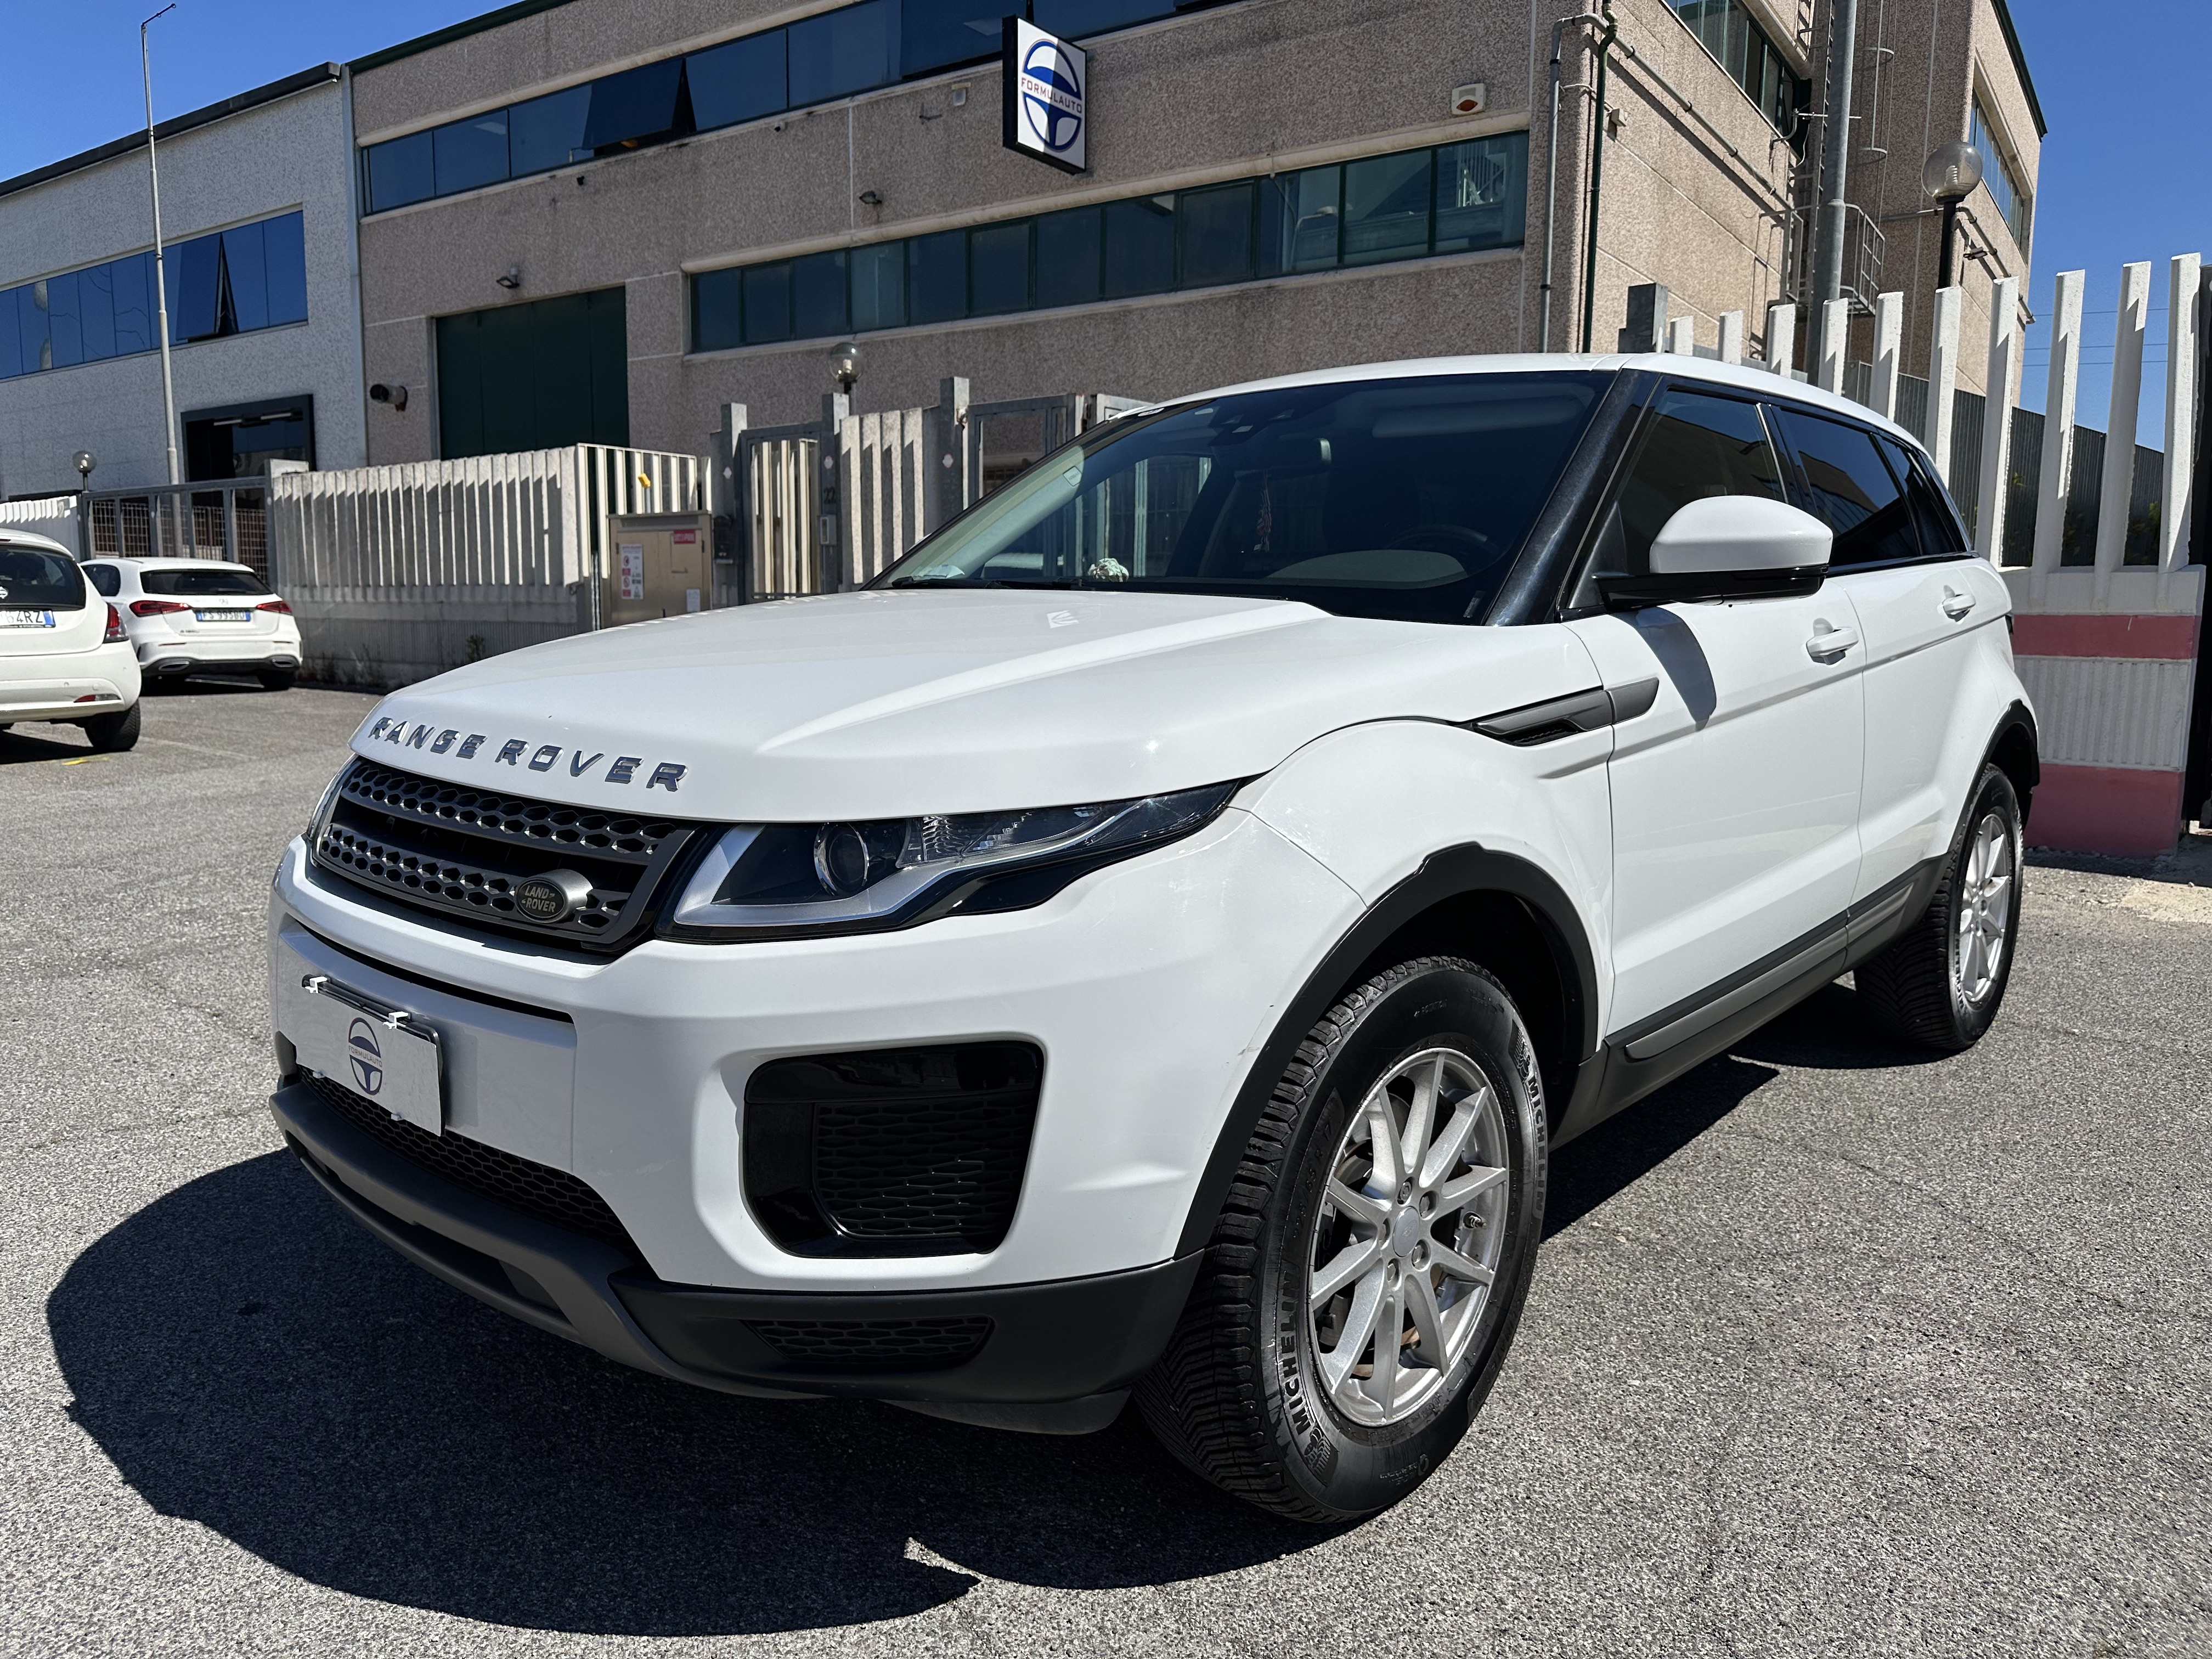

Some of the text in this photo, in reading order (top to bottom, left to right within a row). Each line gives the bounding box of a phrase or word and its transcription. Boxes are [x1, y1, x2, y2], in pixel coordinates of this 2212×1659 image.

[1021, 77, 1082, 114] FORMULAUTO
[368, 716, 688, 792] RANGE ROVER
[524, 885, 549, 899] LAND
[526, 898, 556, 913] ROVER
[348, 1045, 382, 1068] FORMULAUTO
[1528, 1075, 1545, 1211] MICHELIN
[1280, 1271, 1311, 1436] MICHELIN
